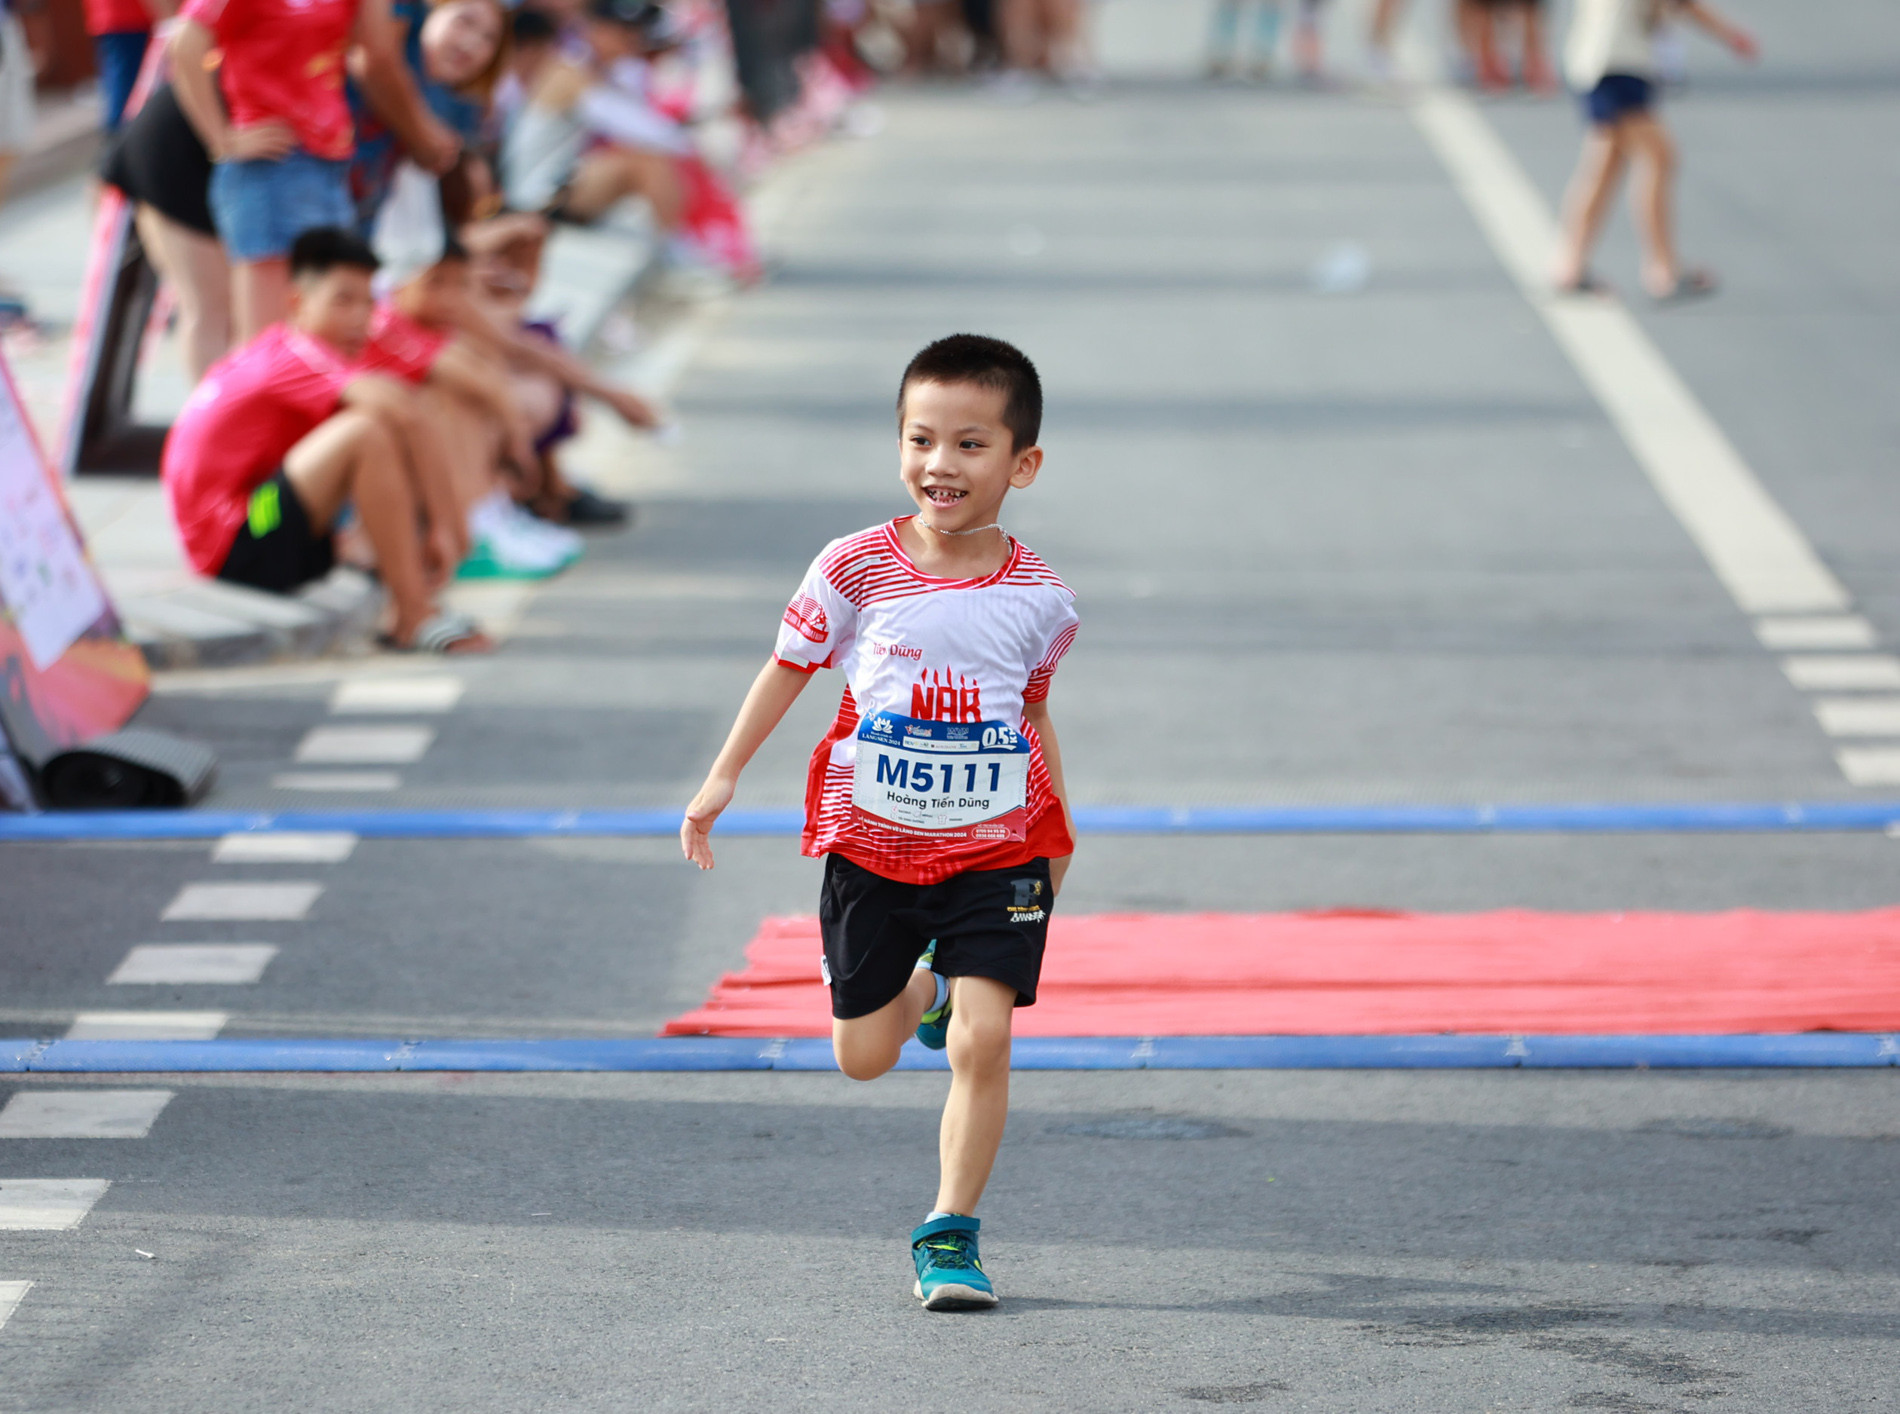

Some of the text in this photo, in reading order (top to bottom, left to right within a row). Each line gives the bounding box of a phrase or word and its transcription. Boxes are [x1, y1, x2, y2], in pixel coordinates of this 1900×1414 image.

[890, 644, 923, 661] Dũng
[876, 753, 1001, 794] M5111
[886, 791, 990, 810] Hoàng Tiến Dũng
